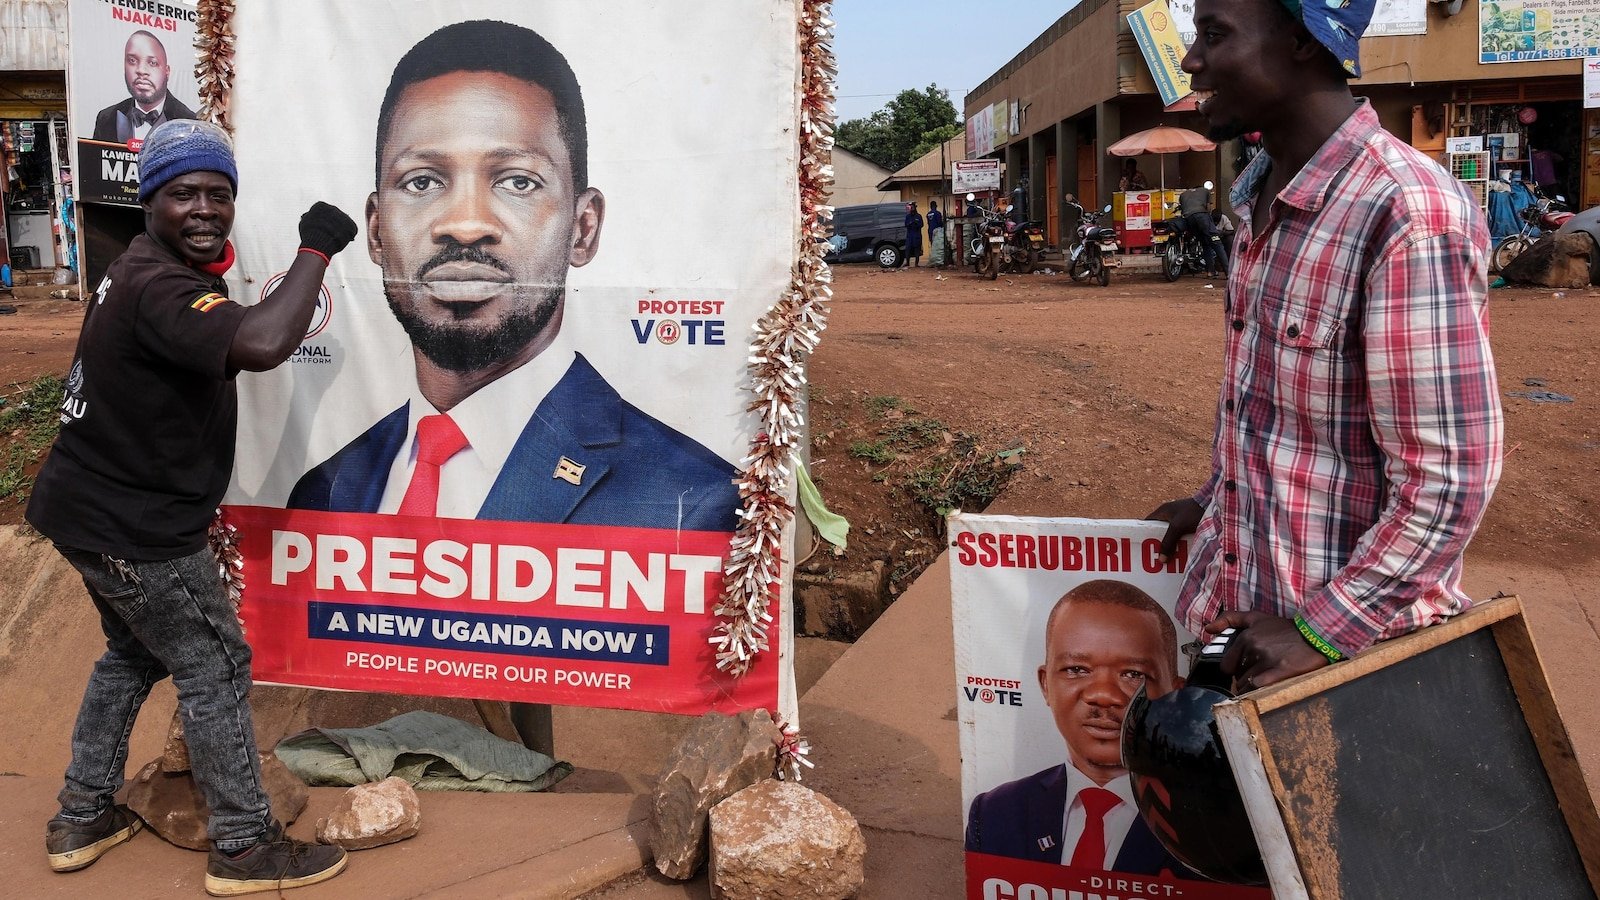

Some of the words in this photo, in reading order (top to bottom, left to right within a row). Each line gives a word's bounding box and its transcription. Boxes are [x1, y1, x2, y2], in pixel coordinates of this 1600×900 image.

[112, 7, 177, 32] NJAKASI
[157, 3, 198, 22] ERRIC
[1163, 43, 1188, 86] ADVANCE
[1495, 51, 1514, 61] Tel:
[1517, 49, 1566, 59] 0771-896
[638, 300, 725, 315] PROTEST
[630, 319, 725, 346] VOTE
[957, 531, 1132, 573] SSERUBIRI
[270, 529, 723, 614] PRESIDENT
[328, 612, 350, 633] A
[357, 613, 424, 639] NEW
[432, 618, 554, 649] UGANDA
[561, 628, 637, 655] NOW
[346, 651, 419, 674] PEOPLE
[425, 660, 498, 681] POWER
[503, 665, 549, 684] OUR
[554, 669, 631, 690] POWER
[967, 676, 1022, 690] PROTEST
[963, 686, 1023, 707] VOTE
